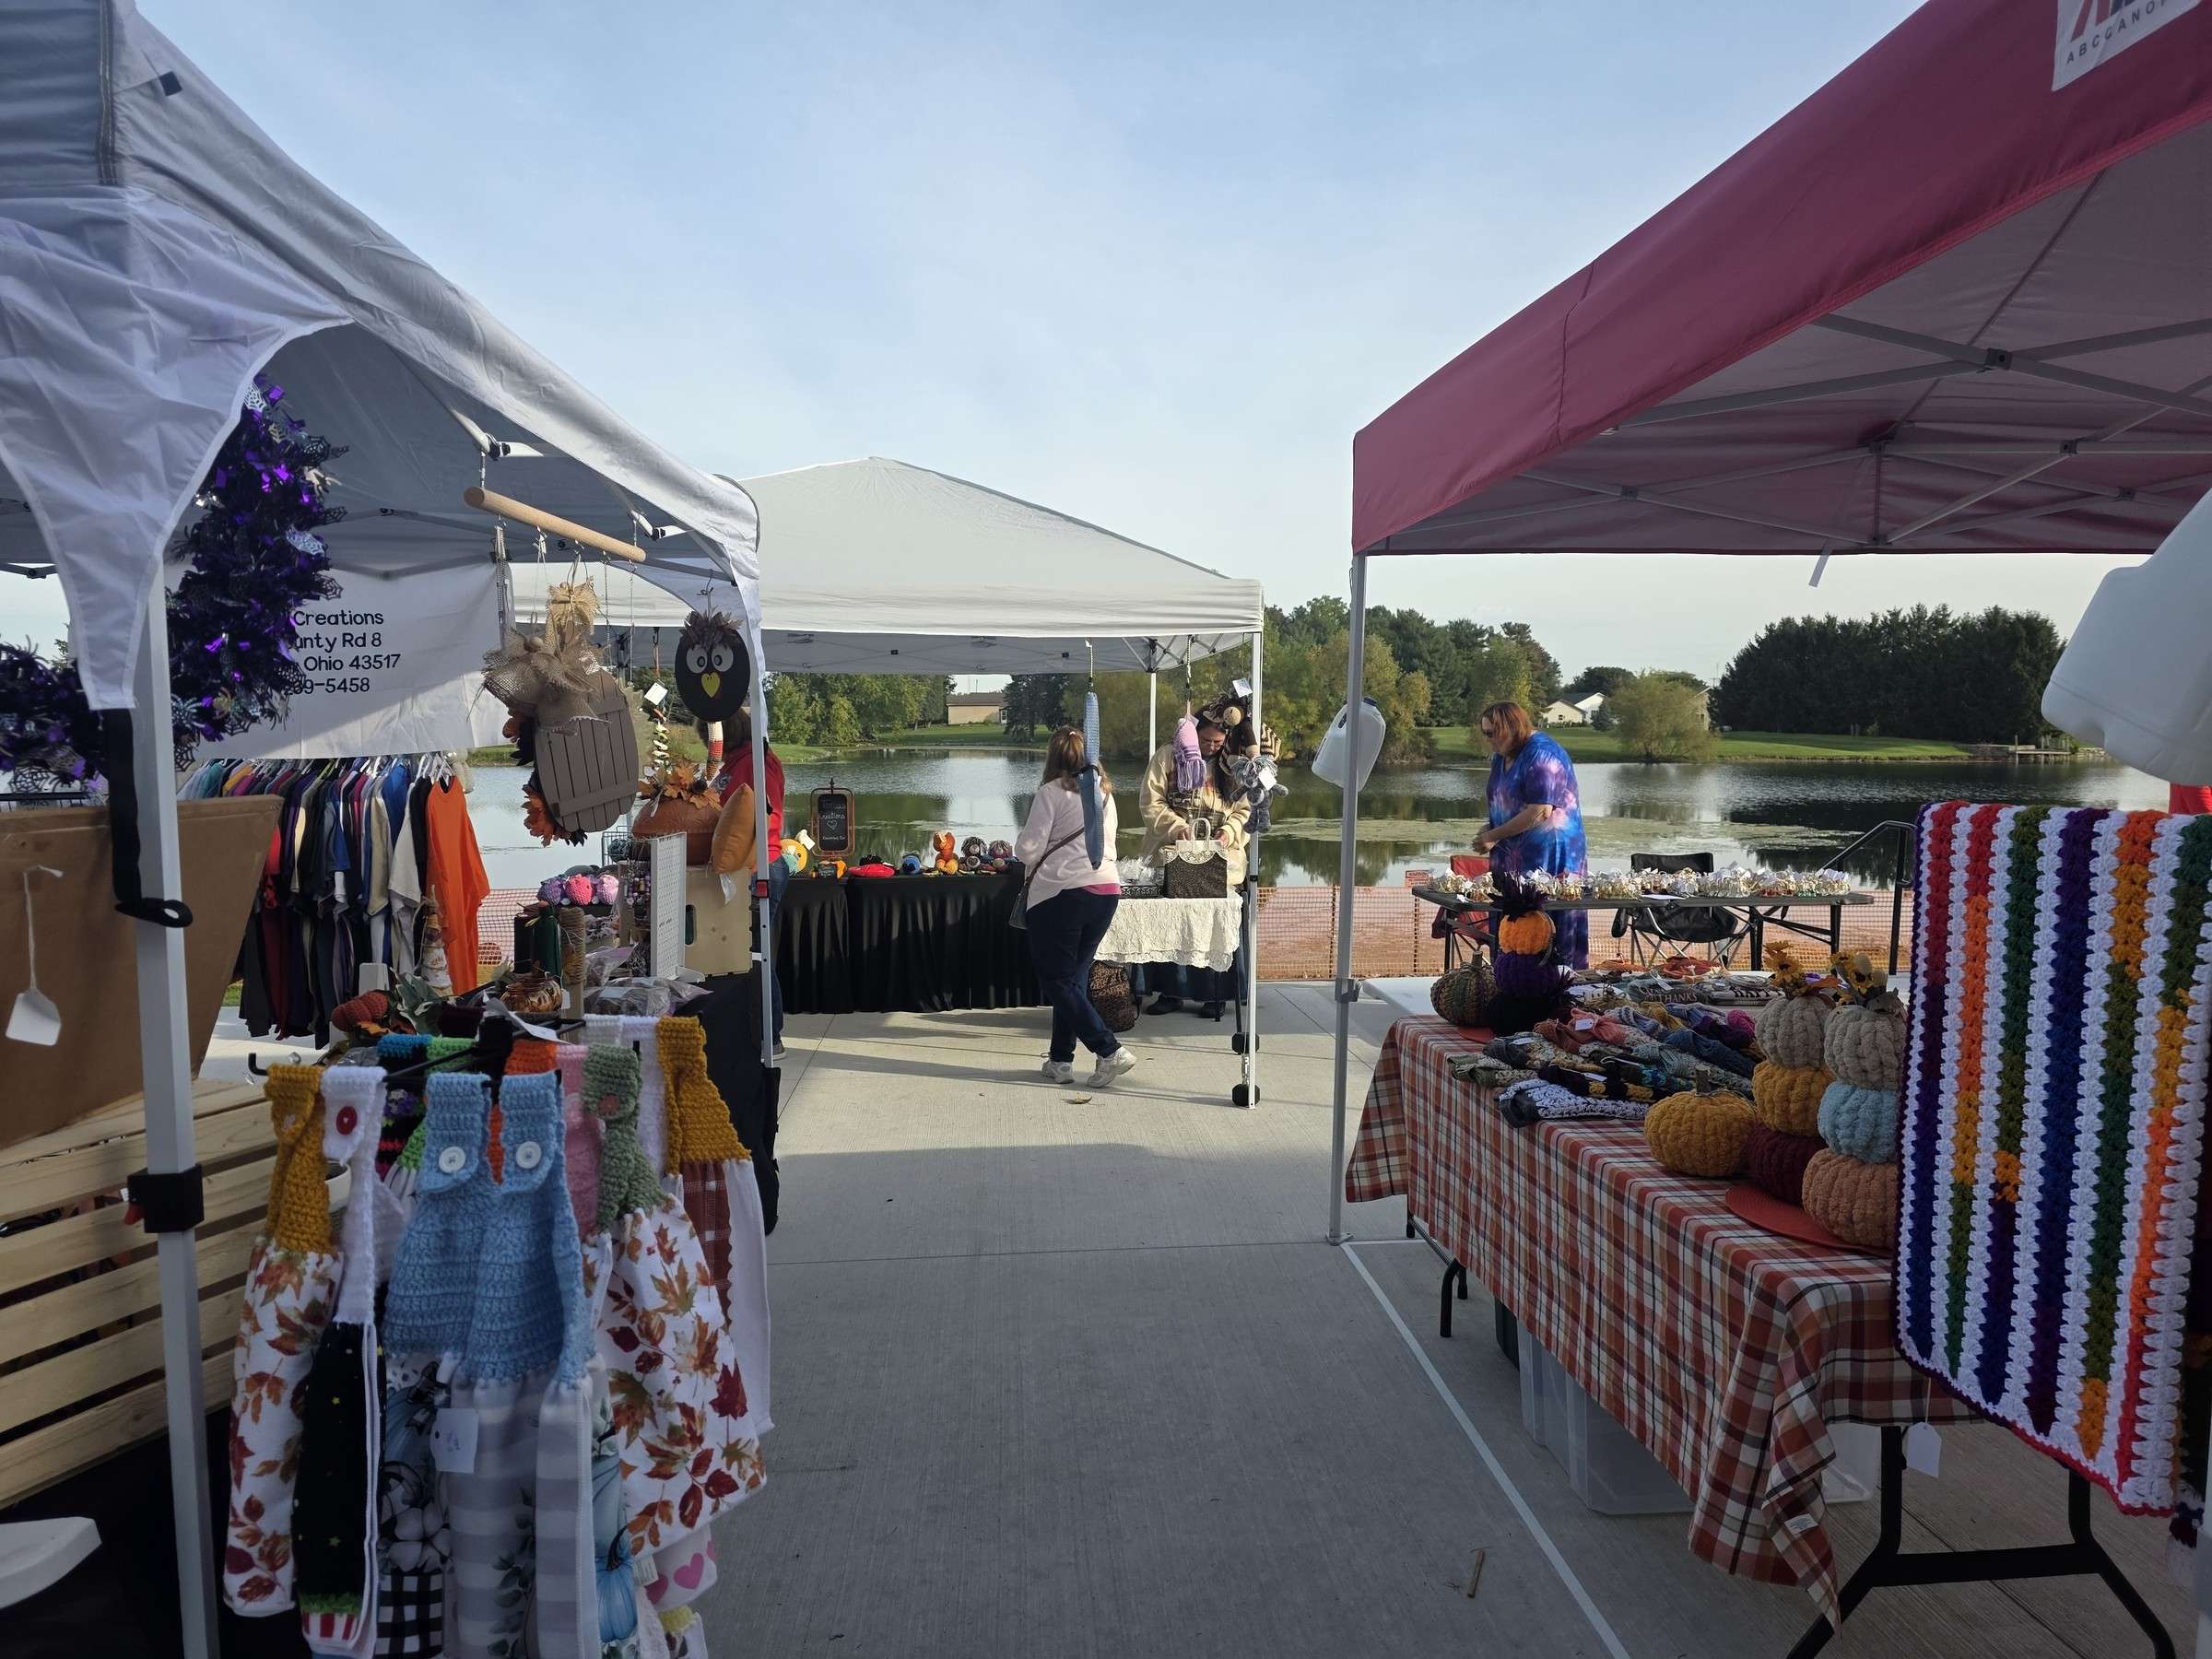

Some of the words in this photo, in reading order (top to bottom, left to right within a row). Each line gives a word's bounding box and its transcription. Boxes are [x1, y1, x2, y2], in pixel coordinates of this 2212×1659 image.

[293, 609, 384, 626] Creations
[295, 632, 337, 653] unty
[342, 632, 367, 647] Rd
[371, 632, 382, 647] 8
[303, 655, 344, 671] Ohio
[348, 653, 401, 670] 43517
[1658, 992, 1698, 1003] THANKS
